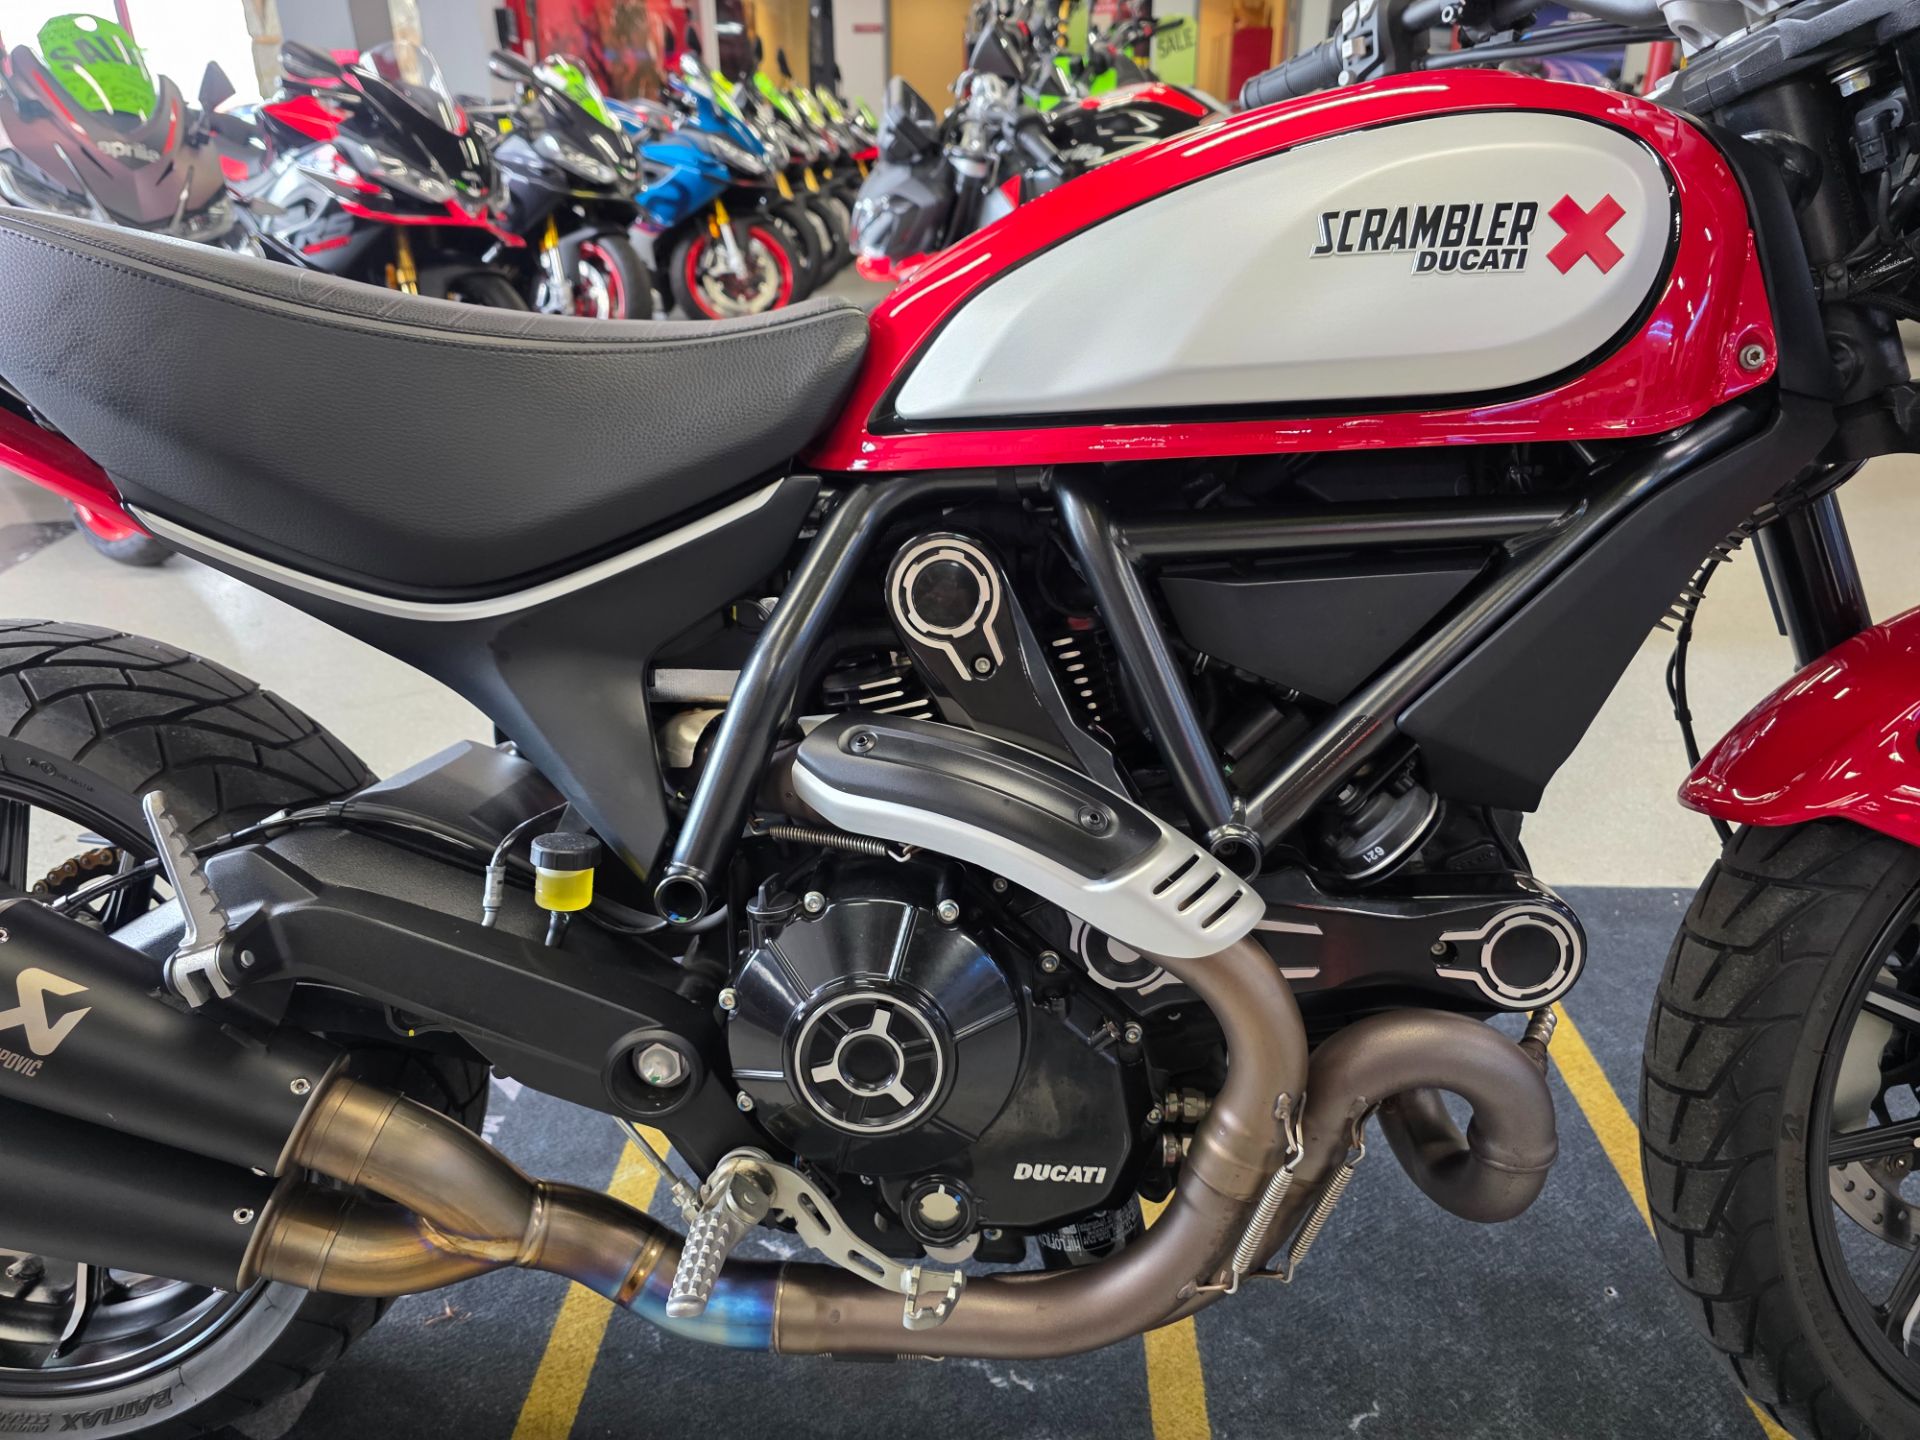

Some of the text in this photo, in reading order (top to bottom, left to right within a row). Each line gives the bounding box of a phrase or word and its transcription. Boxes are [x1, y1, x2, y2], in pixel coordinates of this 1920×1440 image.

[1310, 201, 1540, 257] SCRAMBLER
[1411, 247, 1529, 275] DUCATI
[1362, 846, 1385, 864] 621
[1013, 1162, 1107, 1184] DUCATI
[59, 1386, 173, 1432] BATTLAX
